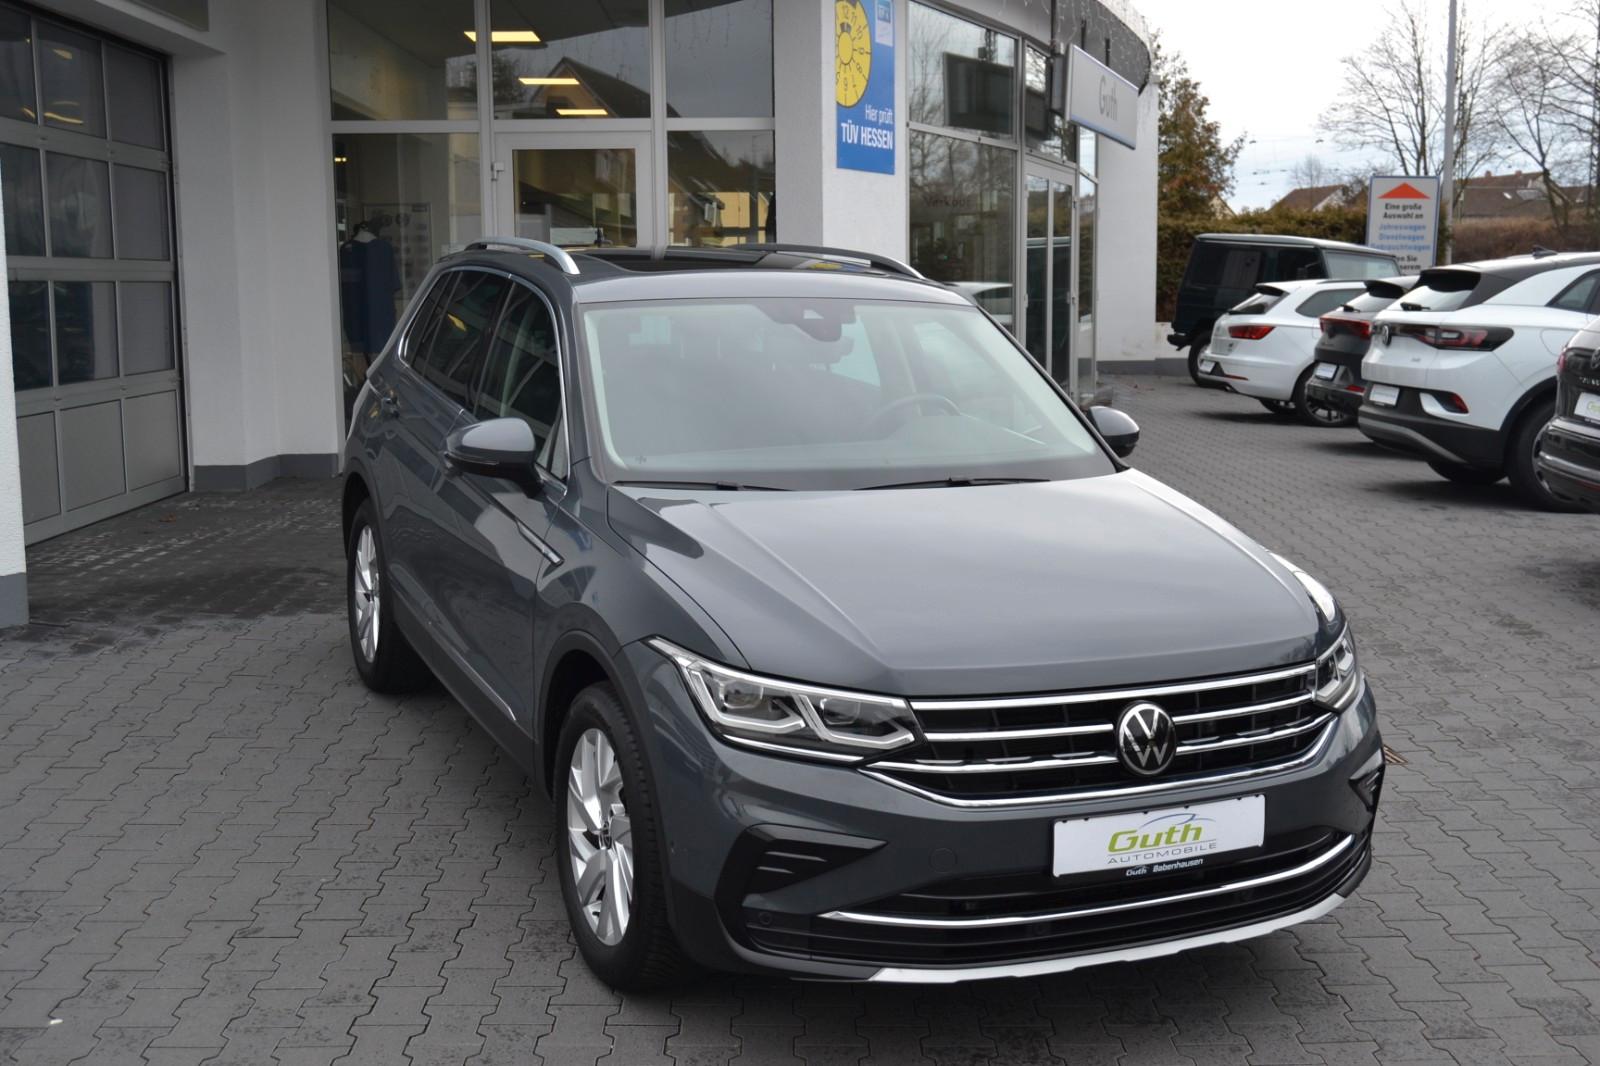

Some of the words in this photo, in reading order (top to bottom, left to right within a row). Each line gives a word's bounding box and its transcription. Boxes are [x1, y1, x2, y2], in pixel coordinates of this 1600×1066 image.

[1099, 75, 1118, 121] Guth
[865, 103, 878, 122] Hier
[879, 107, 893, 126] prüft
[841, 119, 859, 144] TÜV
[860, 126, 893, 150] HESSEN
[1402, 203, 1422, 211] große
[1107, 824, 1203, 853] Guth
[1107, 842, 1217, 865] AUTOMOBILE
[1125, 866, 1148, 877] Guth
[1152, 859, 1204, 873] Babenhausen
